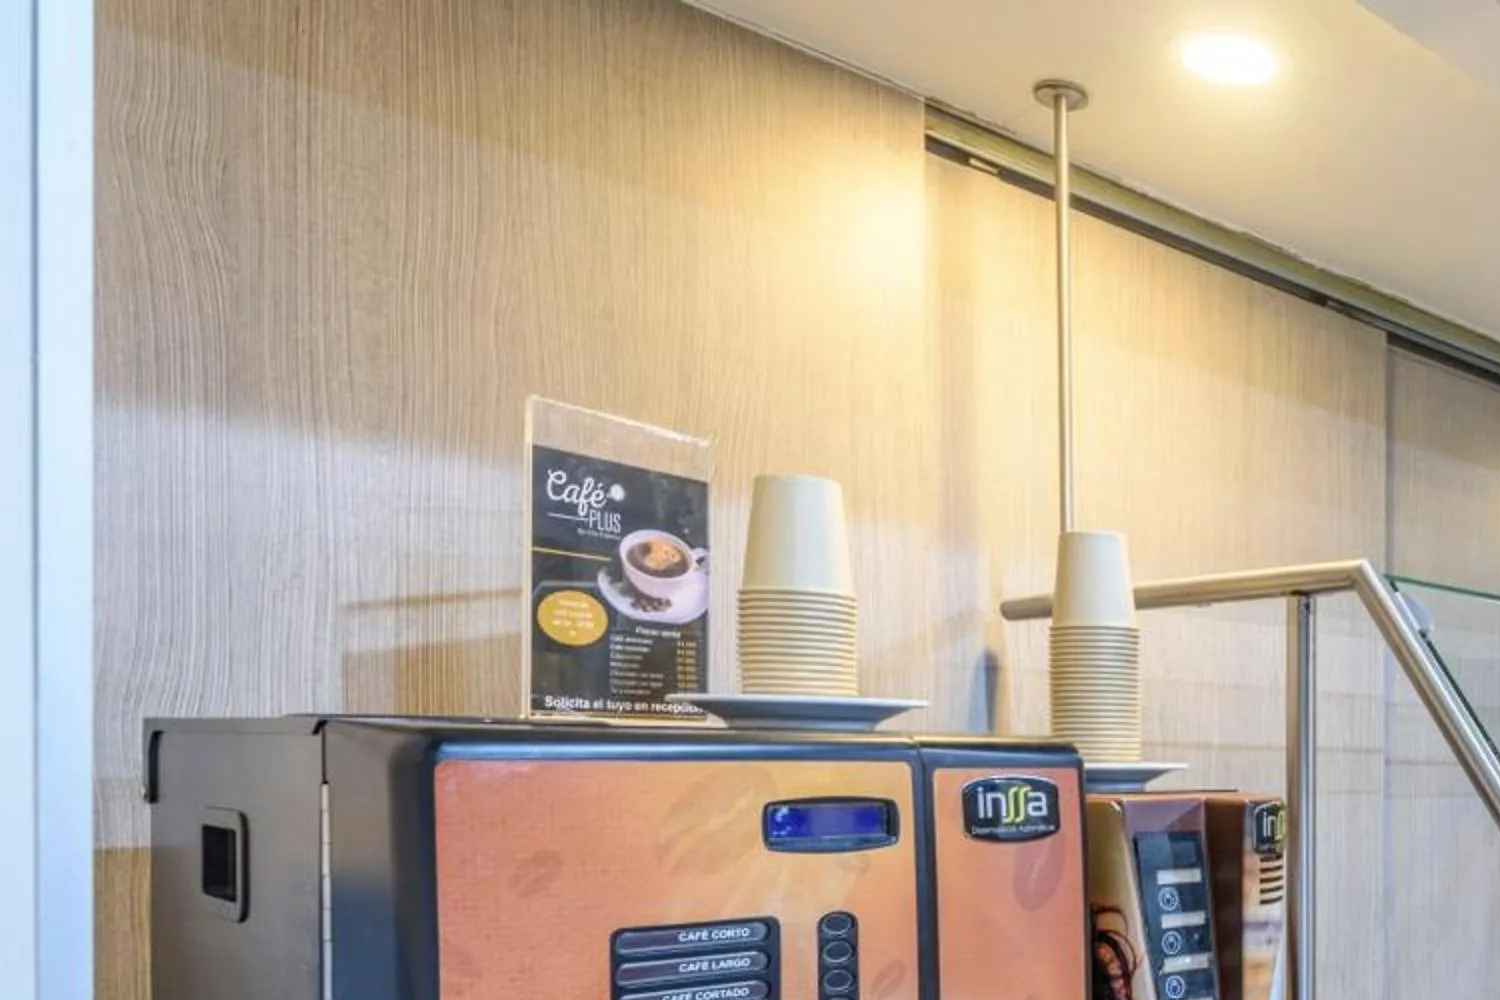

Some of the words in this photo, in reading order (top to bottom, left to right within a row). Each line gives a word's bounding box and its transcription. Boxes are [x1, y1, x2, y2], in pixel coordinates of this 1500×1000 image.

[546, 469, 607, 516] Café
[589, 509, 621, 533] PLUS
[544, 695, 590, 709] Solicita
[593, 698, 604, 709] el
[606, 699, 632, 713] tuyo
[634, 701, 648, 711] en
[711, 927, 750, 939] CORTO
[711, 957, 751, 970] LARGO
[695, 987, 749, 1000] CORTADO
